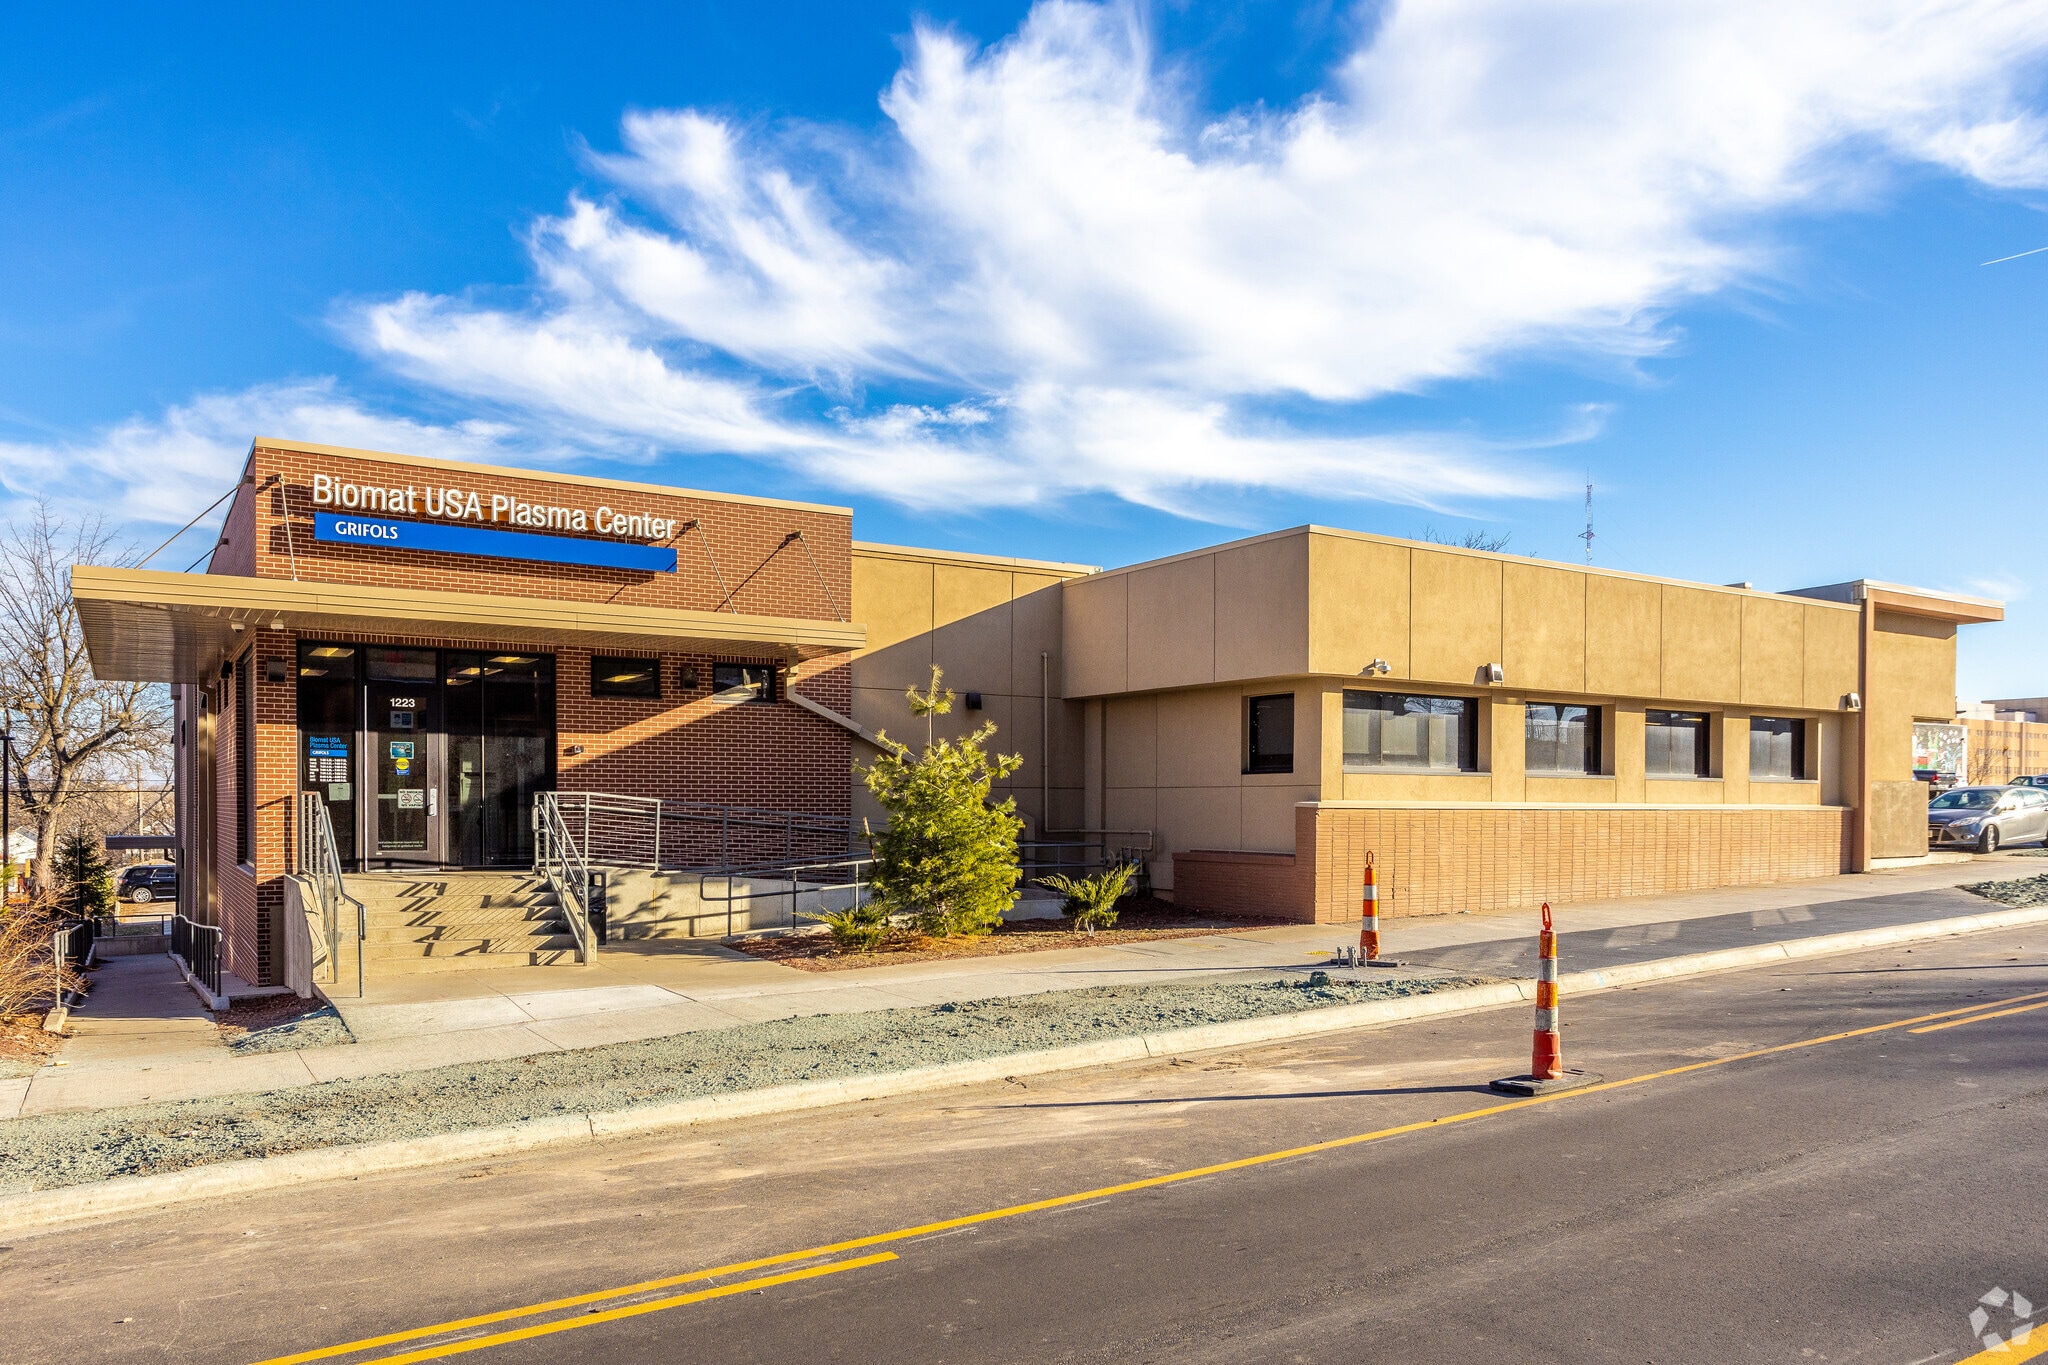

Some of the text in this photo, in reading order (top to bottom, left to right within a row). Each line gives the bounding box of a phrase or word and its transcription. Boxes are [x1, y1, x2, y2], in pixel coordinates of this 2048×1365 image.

[313, 473, 677, 539] Biomat USA Plasma Center
[335, 521, 399, 540] GRIFOLS
[390, 698, 415, 708] 1223
